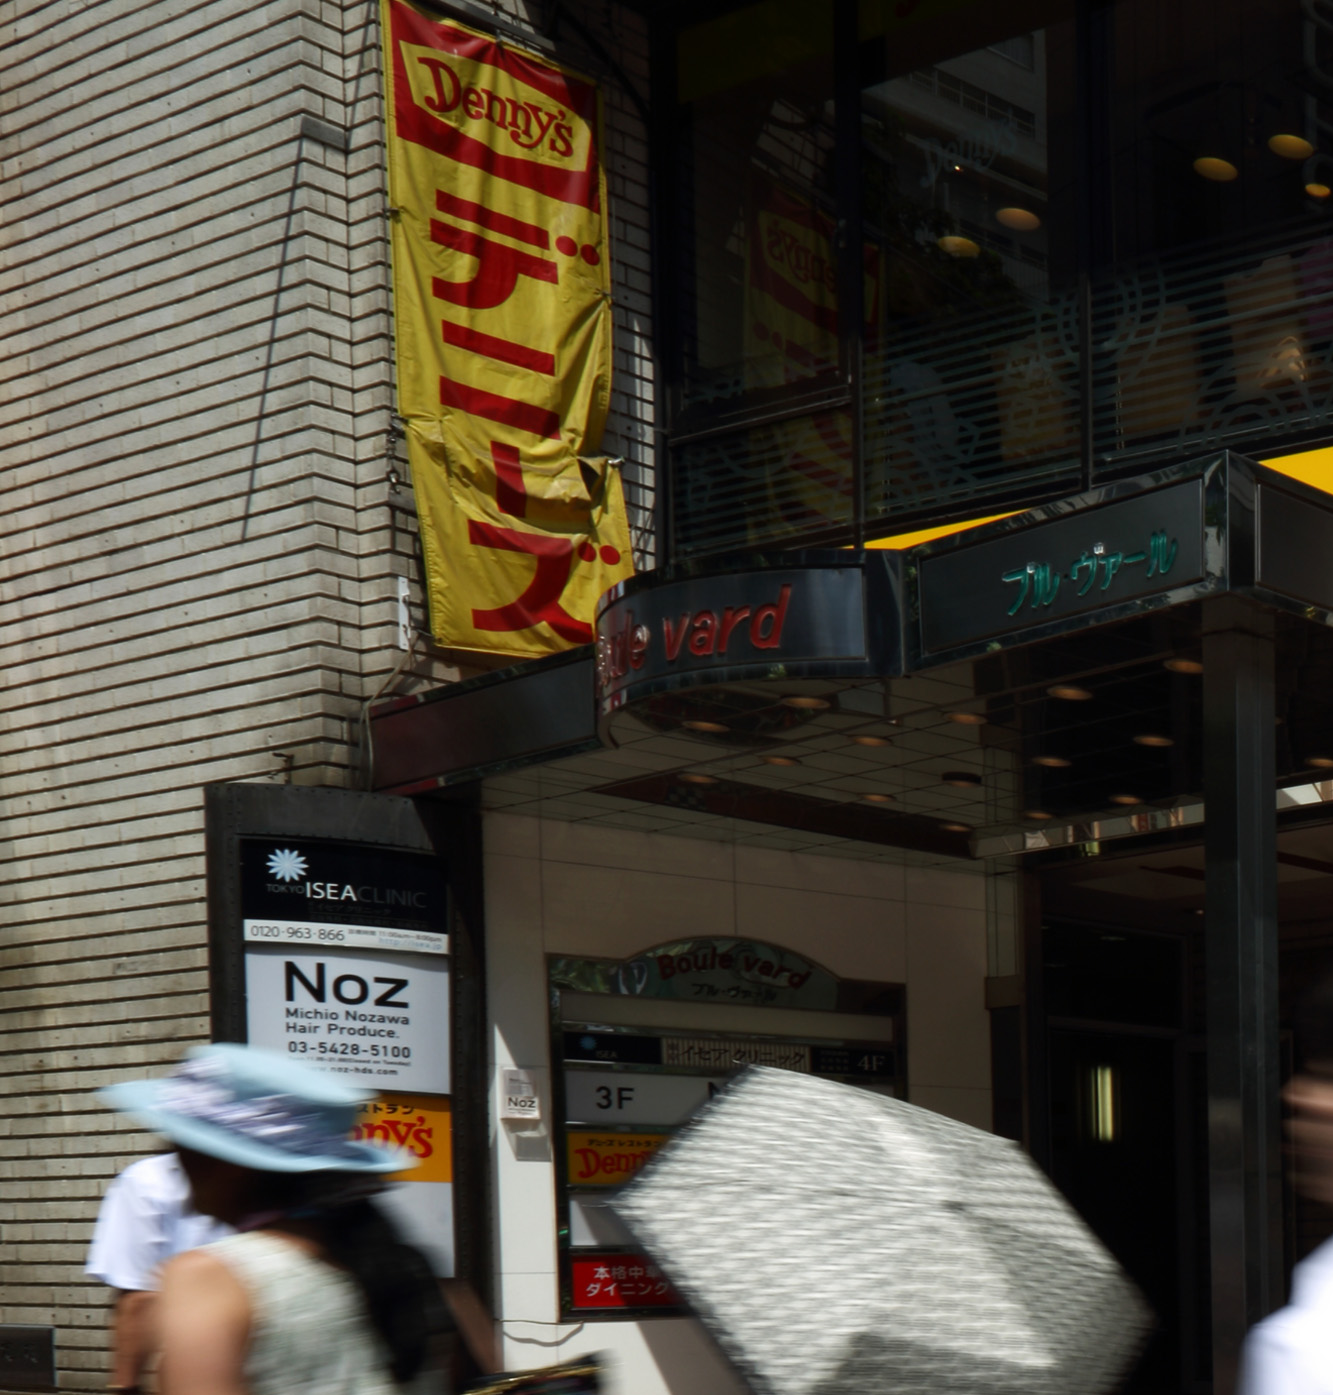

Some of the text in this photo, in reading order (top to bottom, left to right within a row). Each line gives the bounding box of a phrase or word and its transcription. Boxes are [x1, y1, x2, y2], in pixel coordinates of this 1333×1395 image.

[417, 57, 573, 158] Denny's
[430, 188, 622, 645] デニーズ
[662, 583, 792, 662] vard
[265, 884, 305, 895] TOKYO
[742, 953, 812, 989] vard
[284, 961, 409, 1009] Noz
[285, 1008, 411, 1025] Michio Nozawa
[286, 1023, 401, 1039] Hair Produce.
[288, 1041, 412, 1059] 03-5428-5100
[856, 1055, 887, 1074] 4F
[507, 1096, 536, 1108] Noz
[595, 1087, 635, 1110] 3F
